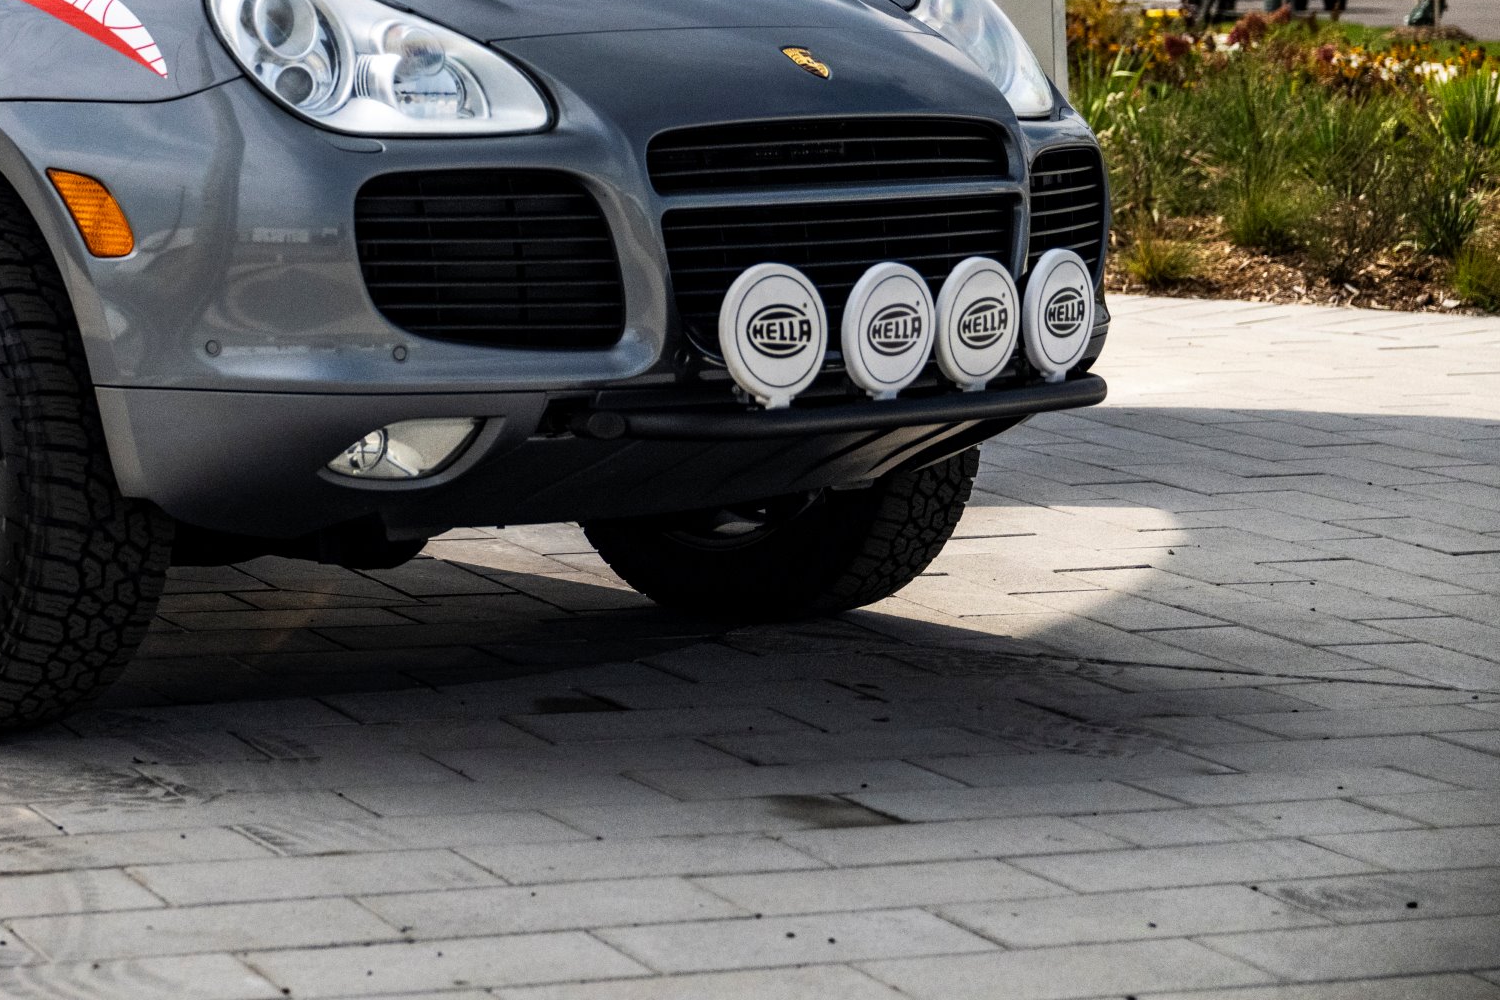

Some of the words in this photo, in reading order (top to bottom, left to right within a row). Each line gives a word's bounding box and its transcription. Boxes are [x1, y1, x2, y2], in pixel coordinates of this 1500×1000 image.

[962, 307, 1009, 335] HELLA
[1048, 297, 1085, 324] HELLA
[752, 317, 812, 343] HELLA
[871, 314, 922, 341] HELLA
